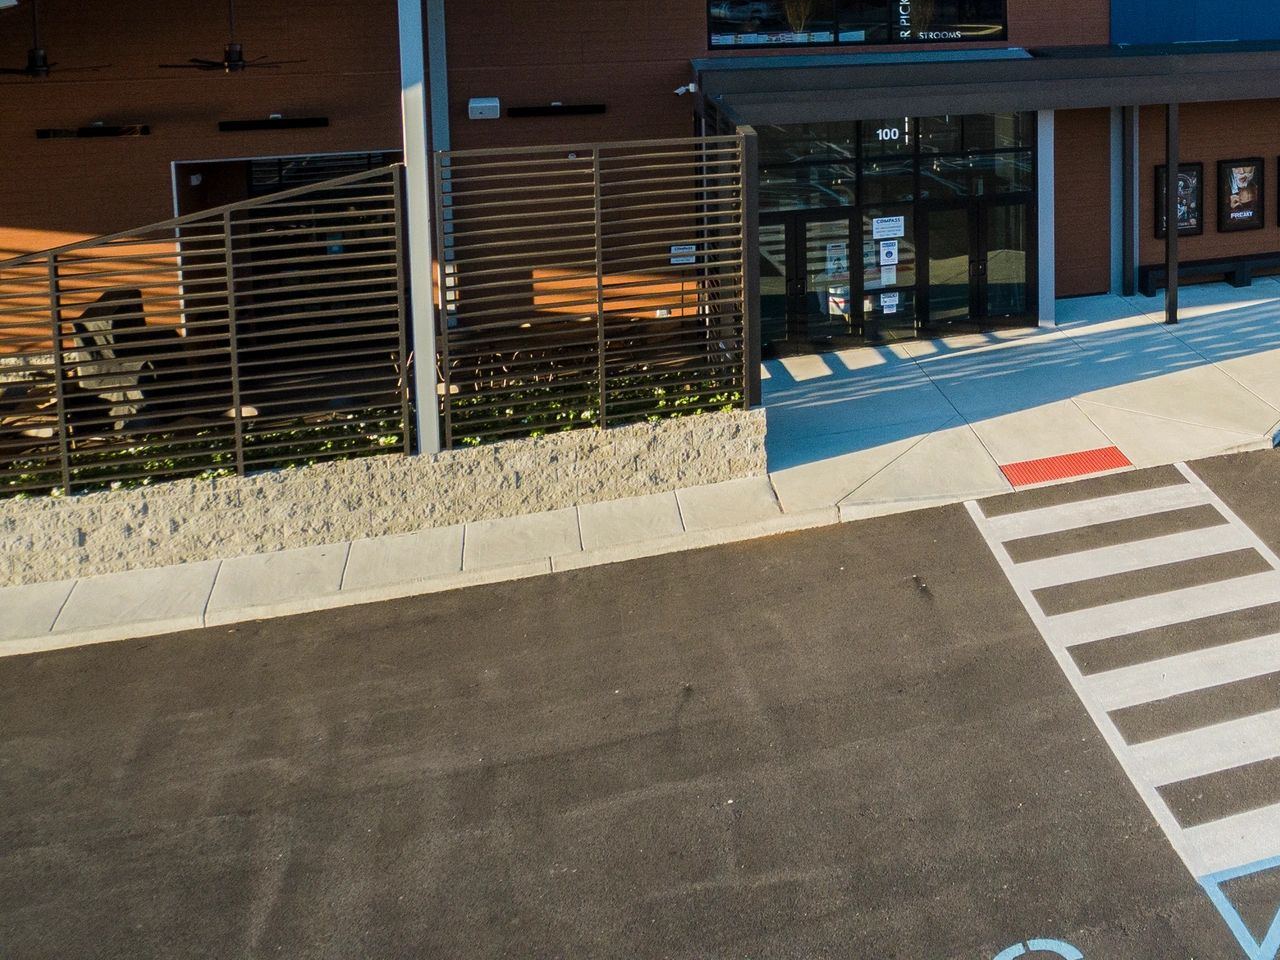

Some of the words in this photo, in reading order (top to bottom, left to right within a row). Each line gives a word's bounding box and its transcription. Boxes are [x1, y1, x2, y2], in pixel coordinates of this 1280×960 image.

[919, 30, 962, 40] STROOMS
[876, 128, 899, 141] 100
[876, 217, 901, 225] COMPASS
